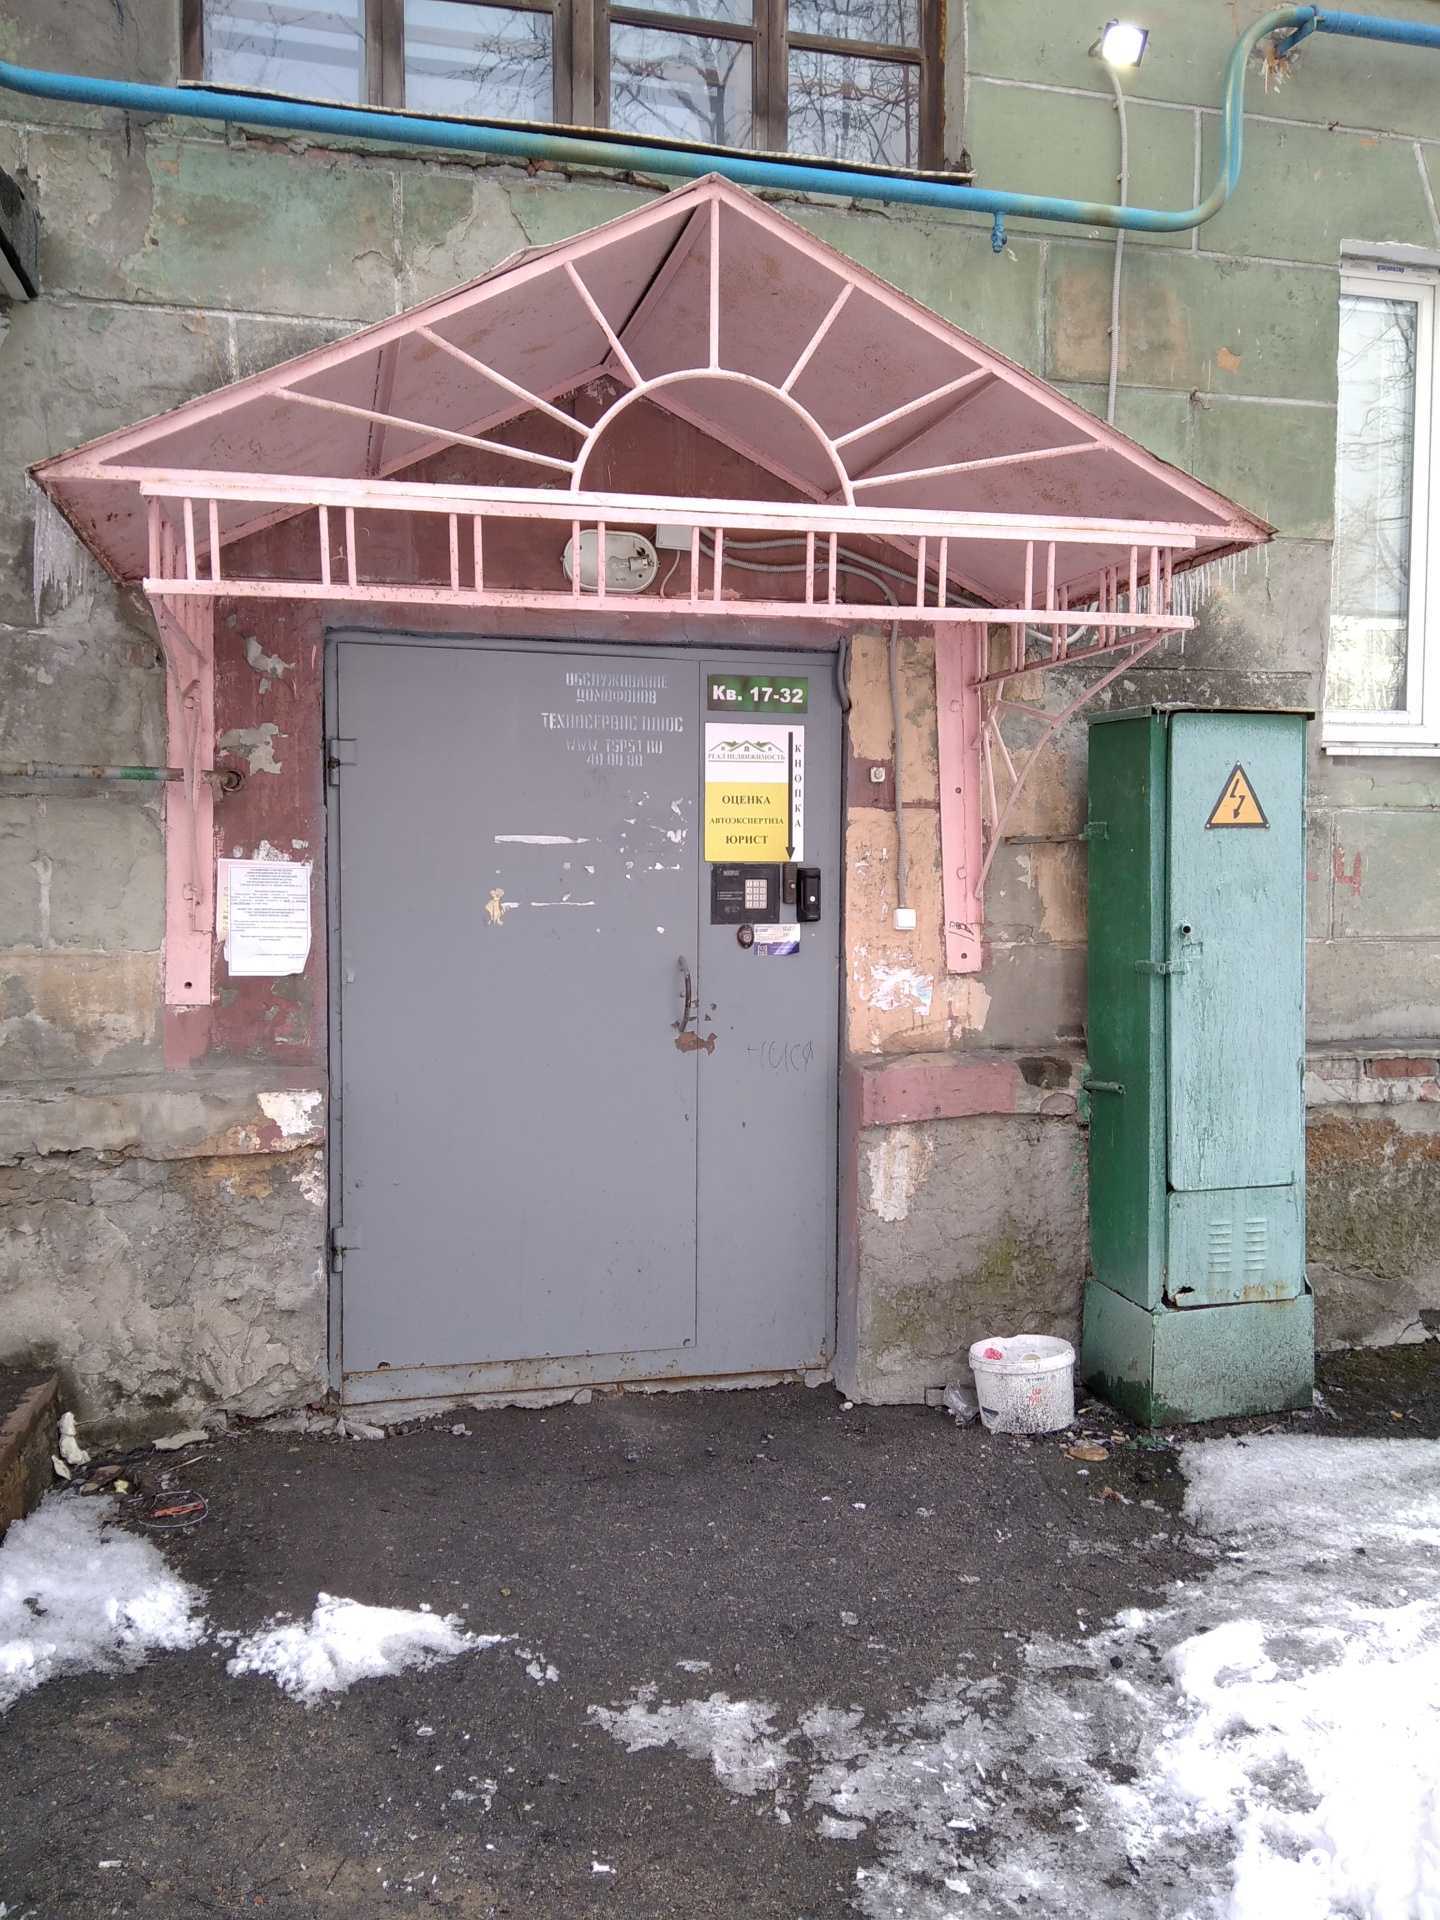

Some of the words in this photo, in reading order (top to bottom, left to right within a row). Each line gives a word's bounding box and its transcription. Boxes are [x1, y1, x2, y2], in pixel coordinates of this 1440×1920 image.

[712, 685, 743, 701] Кв.
[750, 686, 804, 704] 17-32
[721, 795, 771, 806] ОЦЕНКА
[709, 817, 784, 825] АВТОЭКСПЕРТИЗА
[726, 835, 768, 845] ЮРИСТ
